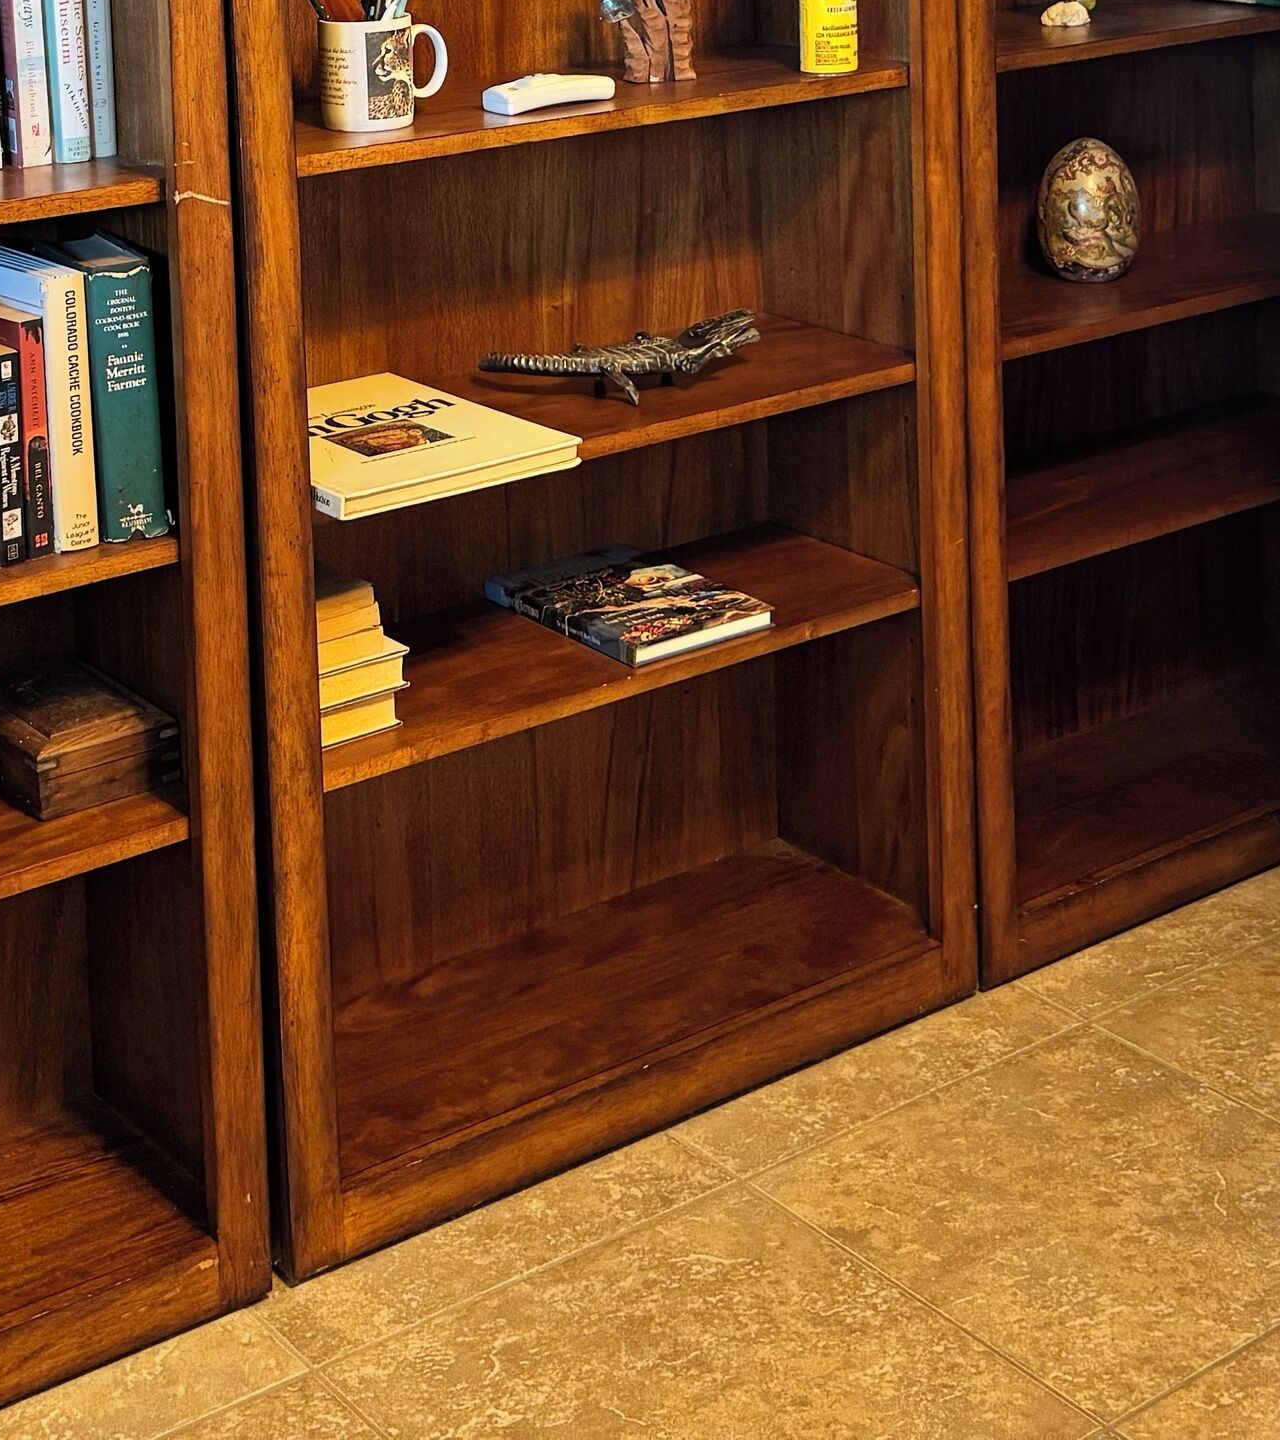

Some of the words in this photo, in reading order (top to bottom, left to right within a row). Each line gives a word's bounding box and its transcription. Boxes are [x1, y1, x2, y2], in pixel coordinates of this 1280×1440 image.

[64, 290, 79, 352] COLORADO
[107, 351, 144, 366] Fannie
[67, 354, 81, 391] CACHE
[106, 363, 146, 380] Merritt
[106, 377, 147, 393] Farmer
[69, 394, 84, 456] COOKBOOK
[34, 461, 42, 480] BEL
[35, 484, 44, 519] CANTO
[65, 529, 89, 540] League
[72, 521, 91, 530] Junior
